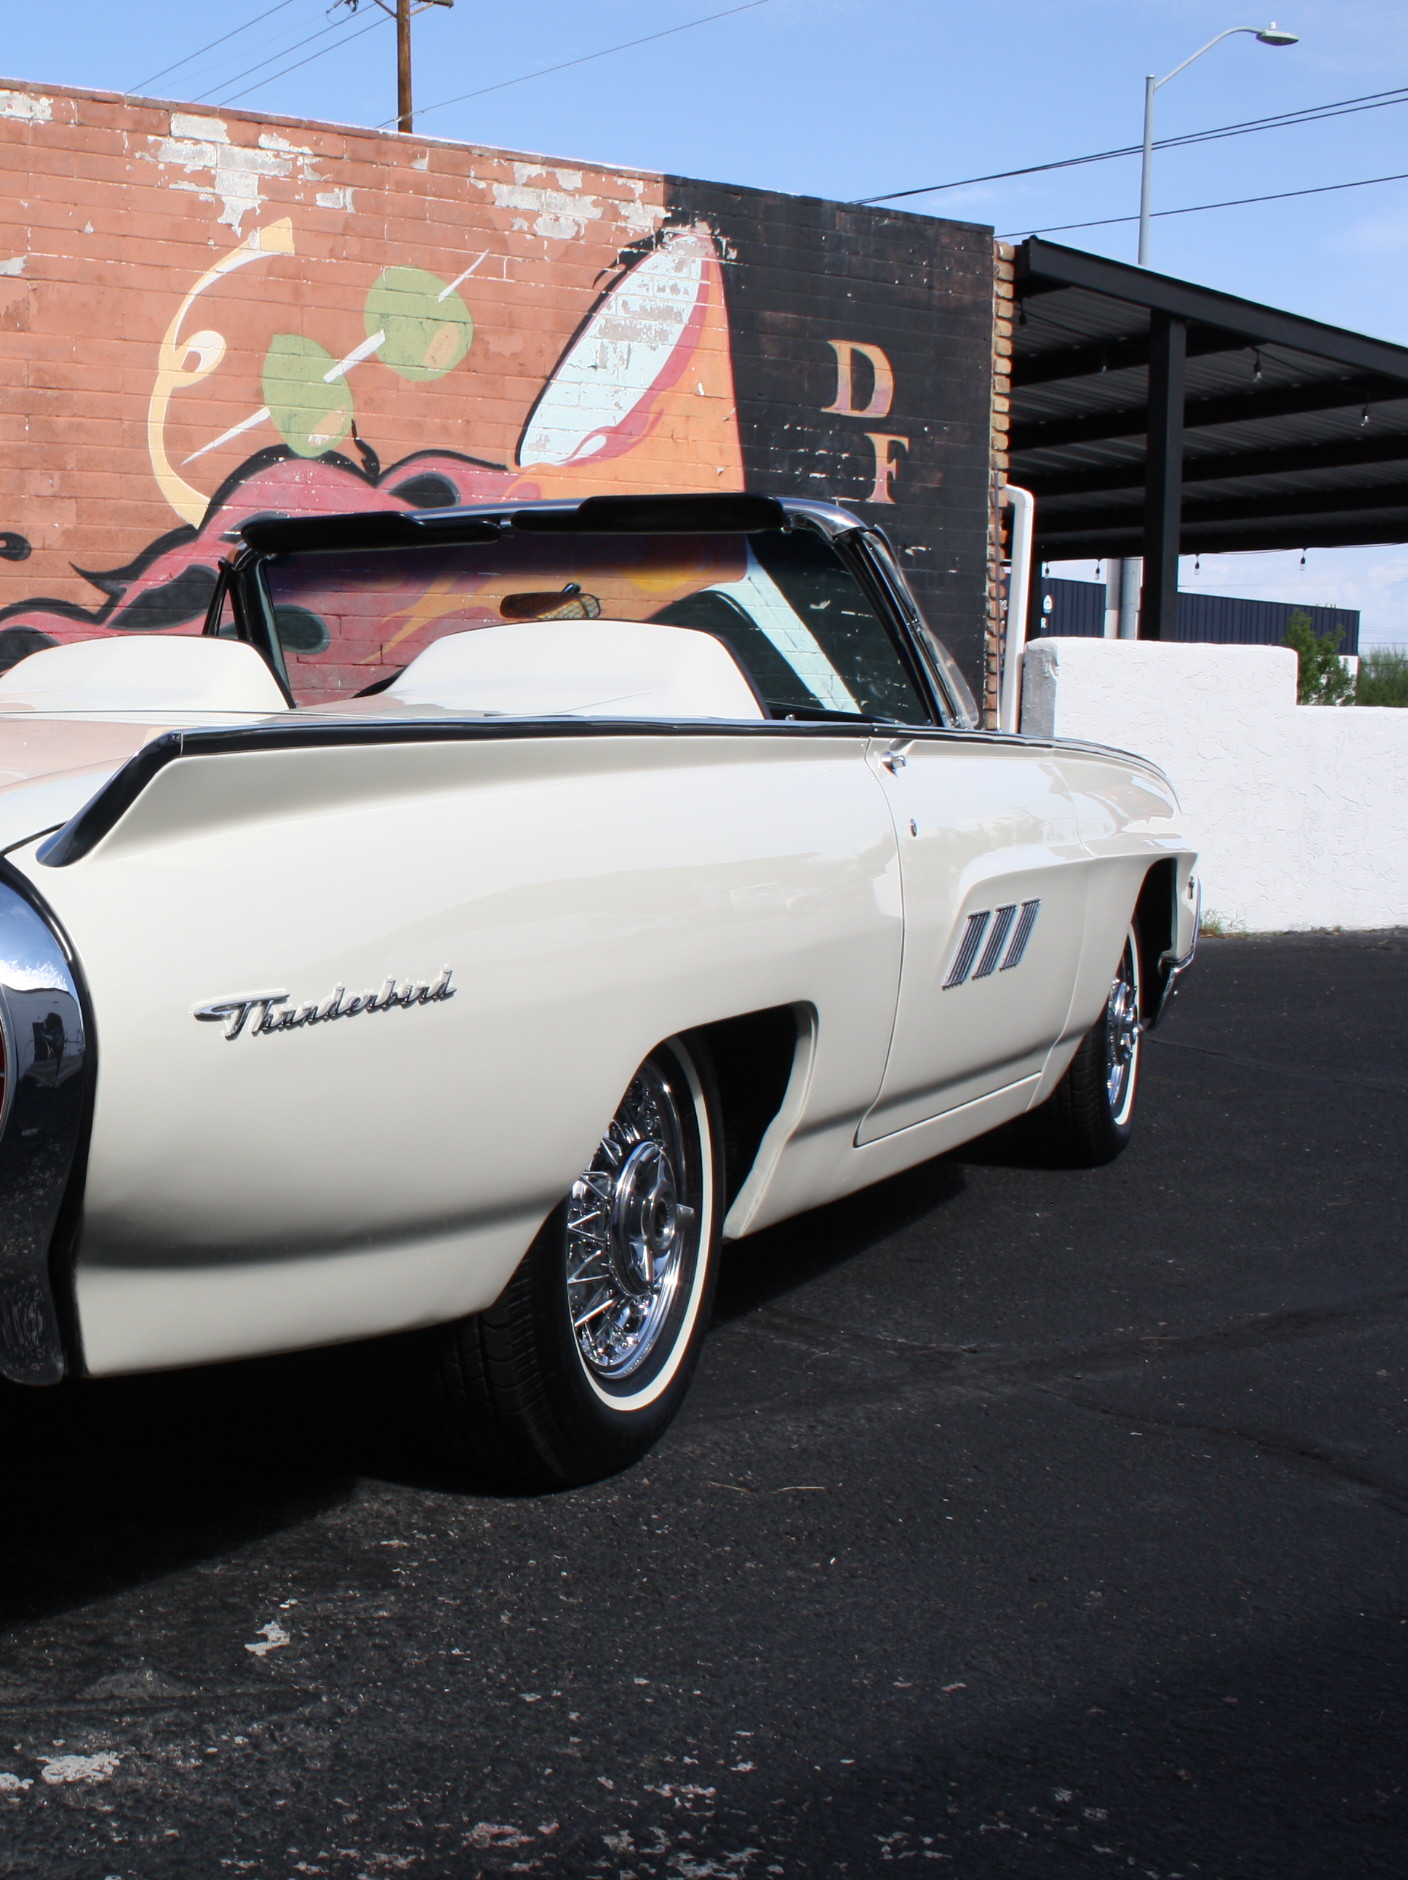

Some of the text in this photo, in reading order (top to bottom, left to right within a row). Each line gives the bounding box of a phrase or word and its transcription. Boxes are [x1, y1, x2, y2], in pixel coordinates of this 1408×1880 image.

[821, 339, 894, 419] D
[864, 432, 910, 504] F
[191, 964, 458, 1042] Thunderbird
